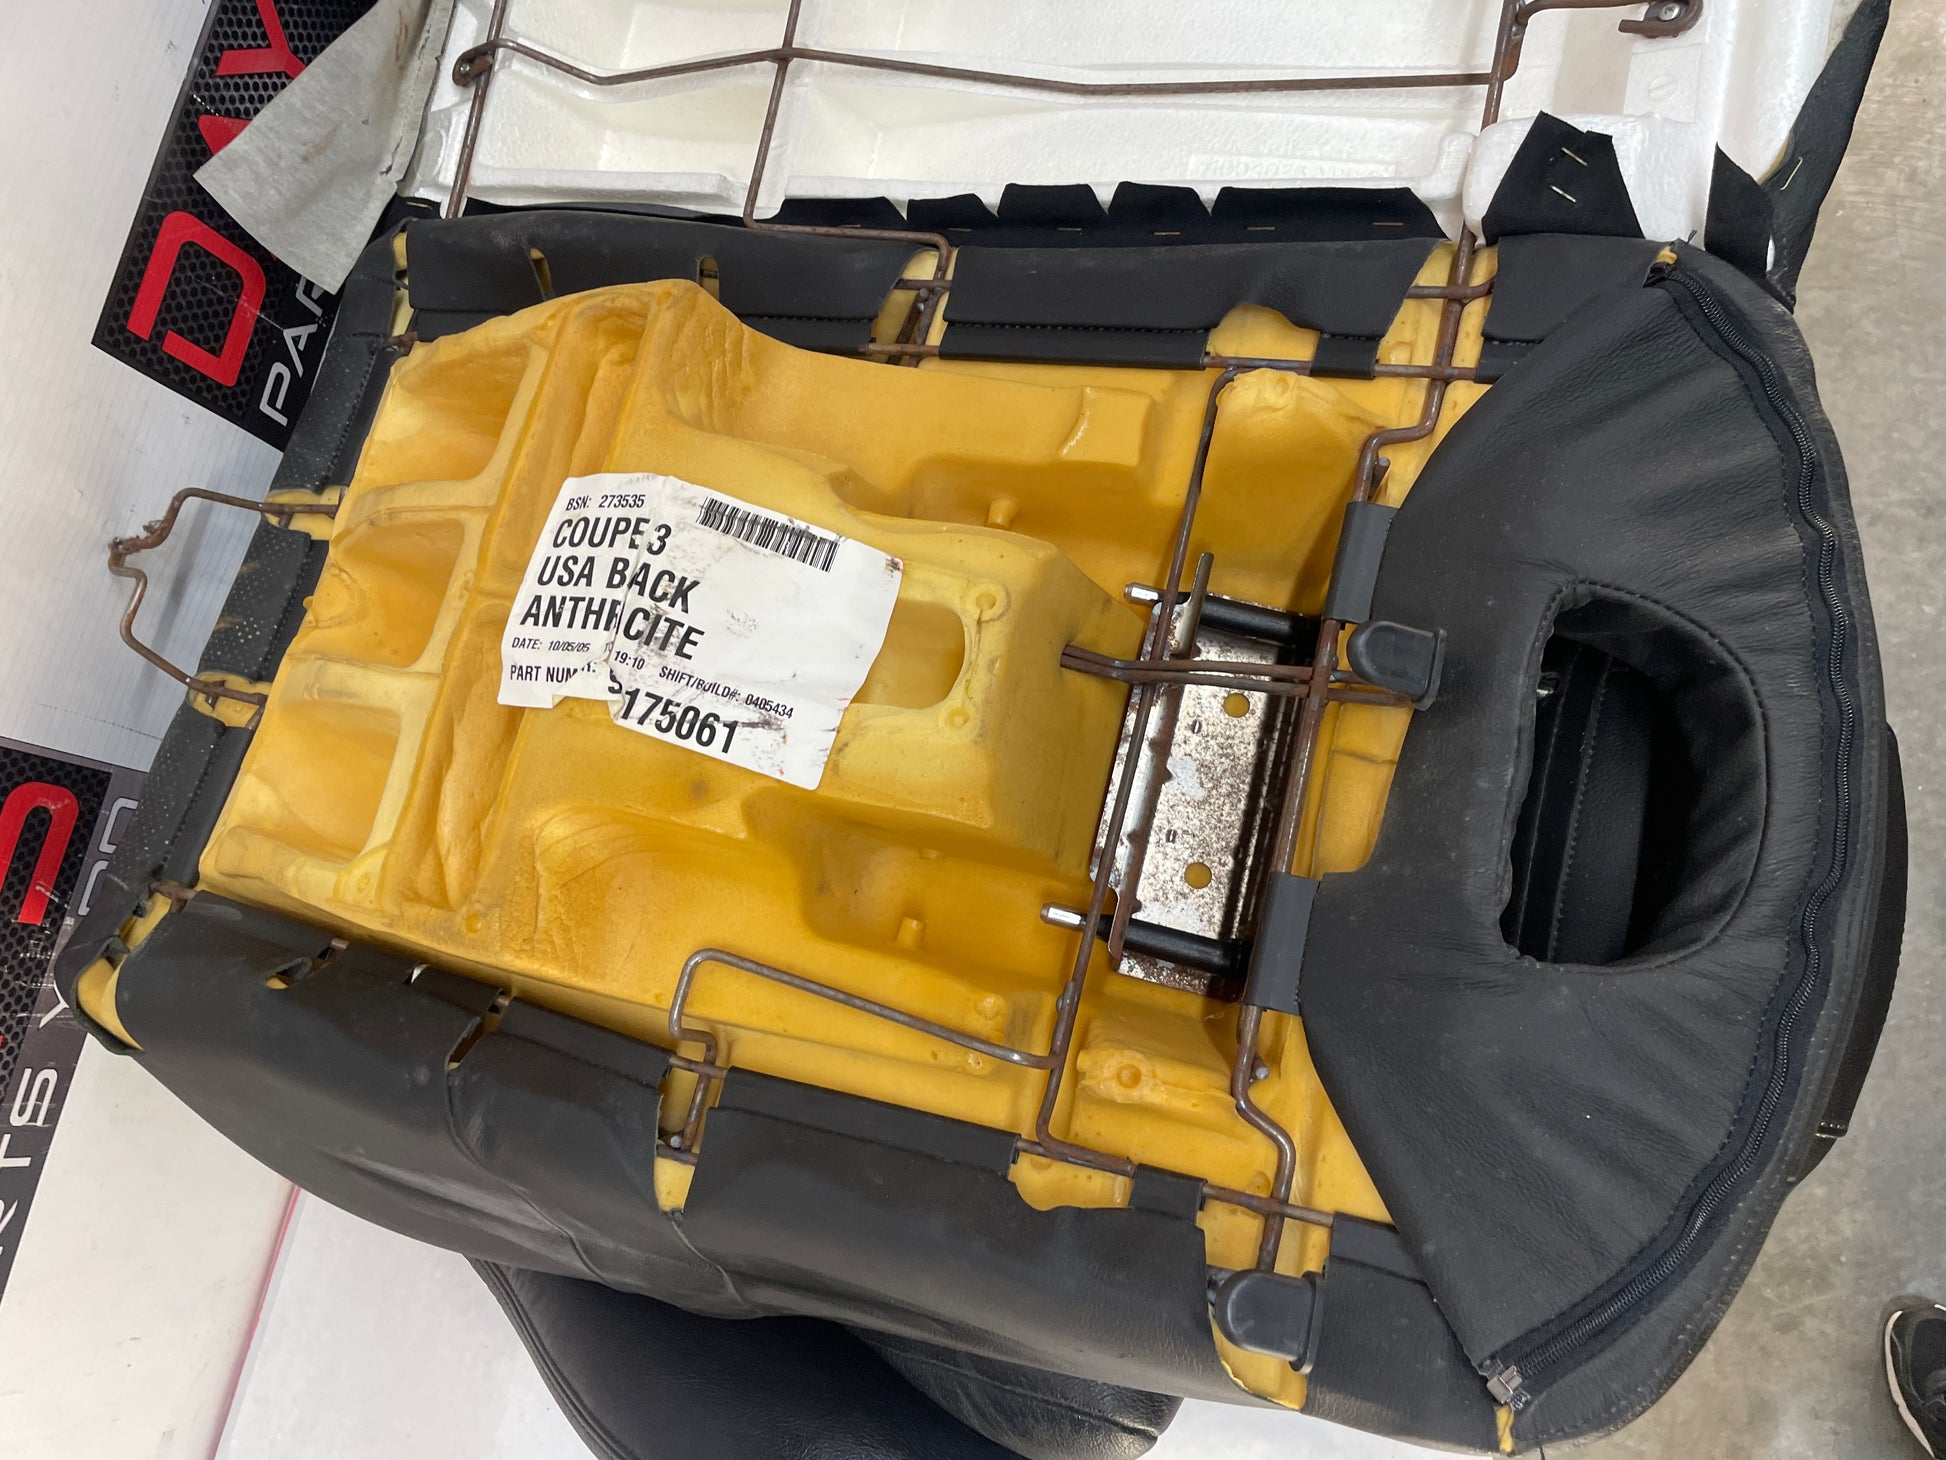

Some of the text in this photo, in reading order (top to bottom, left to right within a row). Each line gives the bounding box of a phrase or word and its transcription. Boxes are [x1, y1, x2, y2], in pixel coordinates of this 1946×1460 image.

[565, 494, 646, 511] BSN: 273535
[552, 516, 672, 555] COUPE 3
[537, 555, 701, 614] USA BACK
[510, 664, 542, 681] PART
[511, 636, 543, 650] DATE:
[548, 640, 591, 653] 10/05/05
[614, 650, 646, 671] 19:10
[745, 692, 794, 719] 0405434
